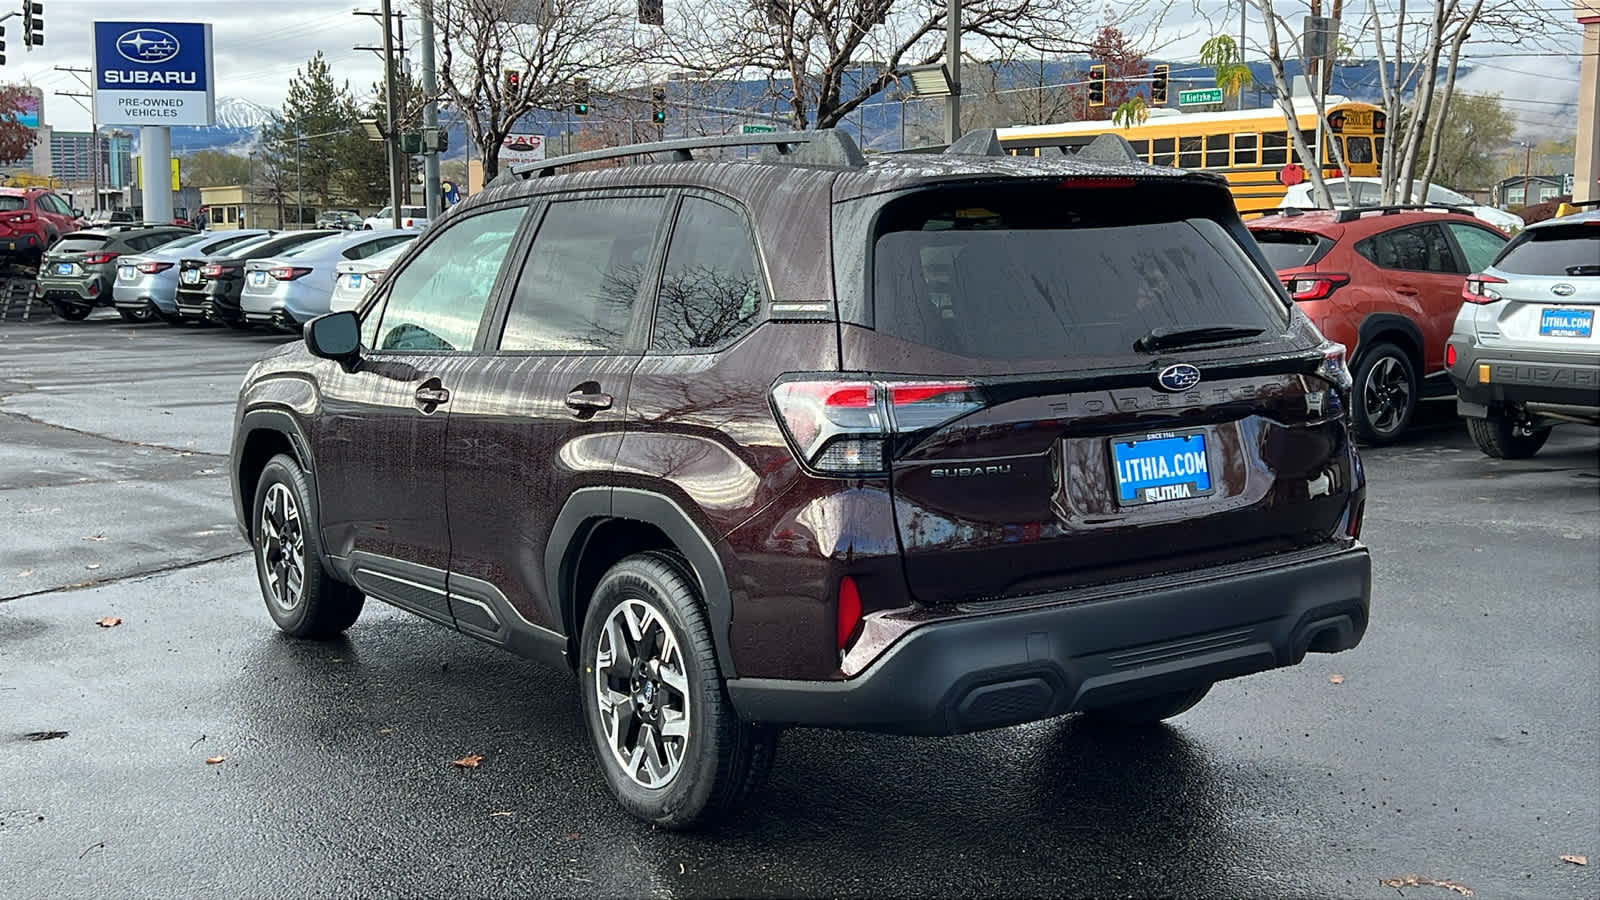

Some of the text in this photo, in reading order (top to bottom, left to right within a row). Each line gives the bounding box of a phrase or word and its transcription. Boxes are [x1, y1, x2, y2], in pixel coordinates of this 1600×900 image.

[104, 70, 196, 84] SUBARU
[118, 98, 184, 108] PRE-OWNED
[1186, 93, 1211, 103] Kietzke
[125, 108, 178, 118] VEHICLES
[1542, 317, 1591, 329] LITHIA.COM
[1048, 382, 1282, 412] FORESTER
[931, 464, 1011, 477] SUBARU
[1116, 450, 1208, 484] LITHIA.COM
[1156, 484, 1191, 501] LITHIA
